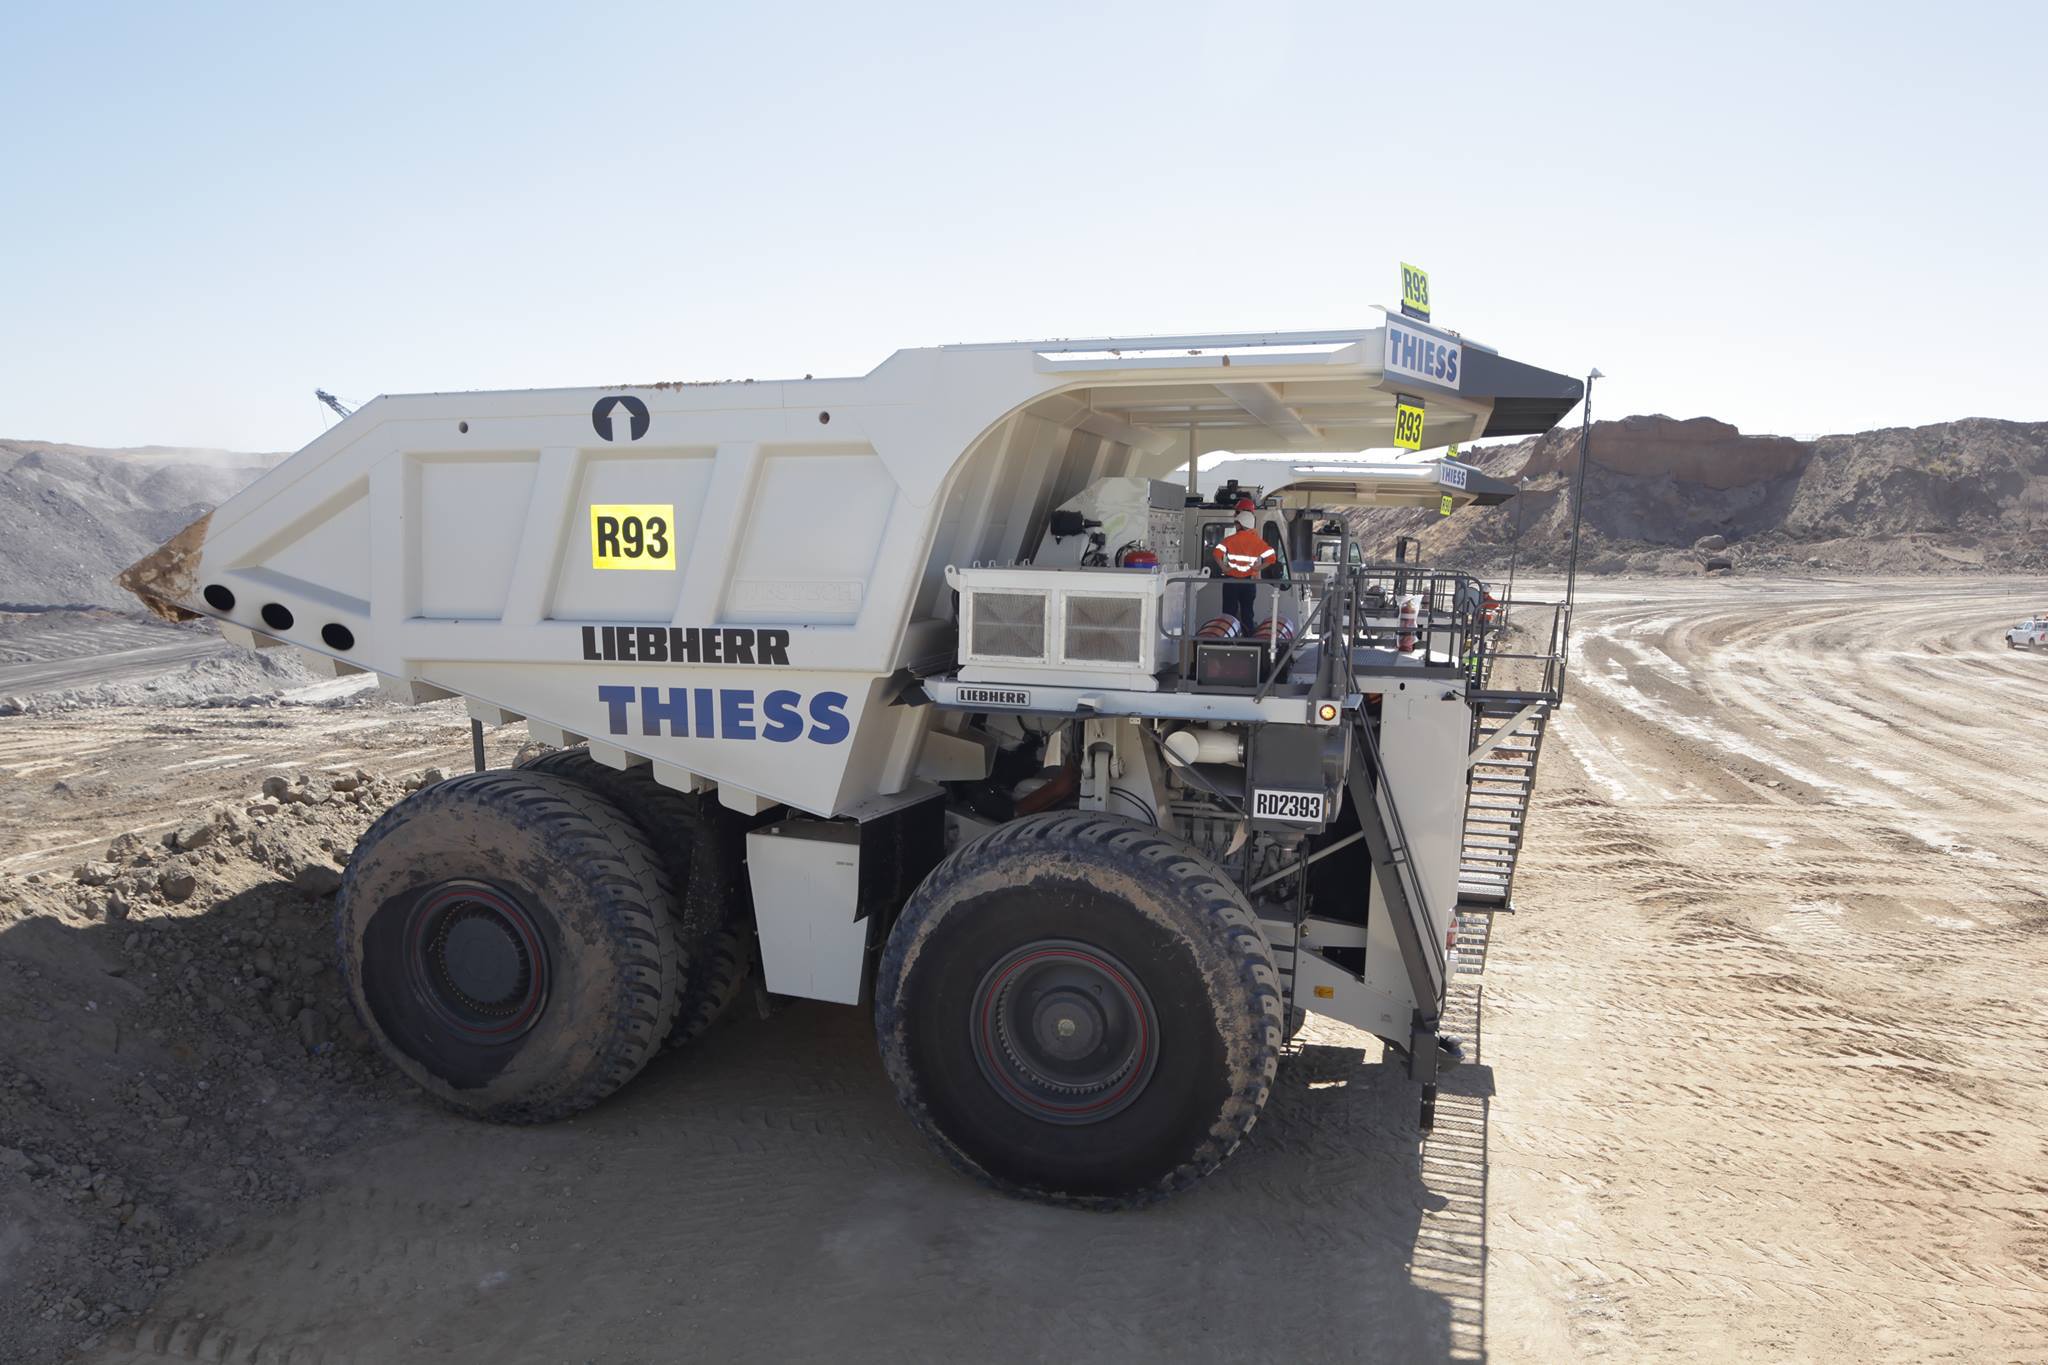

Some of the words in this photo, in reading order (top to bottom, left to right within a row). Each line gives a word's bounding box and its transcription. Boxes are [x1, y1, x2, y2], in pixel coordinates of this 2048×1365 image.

[1403, 268, 1428, 305] R93
[1390, 328, 1457, 383] THIESS
[1396, 411, 1421, 444] R93
[1442, 466, 1465, 486] THIESS
[597, 516, 668, 559] R93
[582, 626, 790, 665] LIEBHERR
[599, 685, 851, 745] THIESS
[960, 690, 1026, 704] LIEBHERR
[1257, 794, 1320, 818] RD2393
